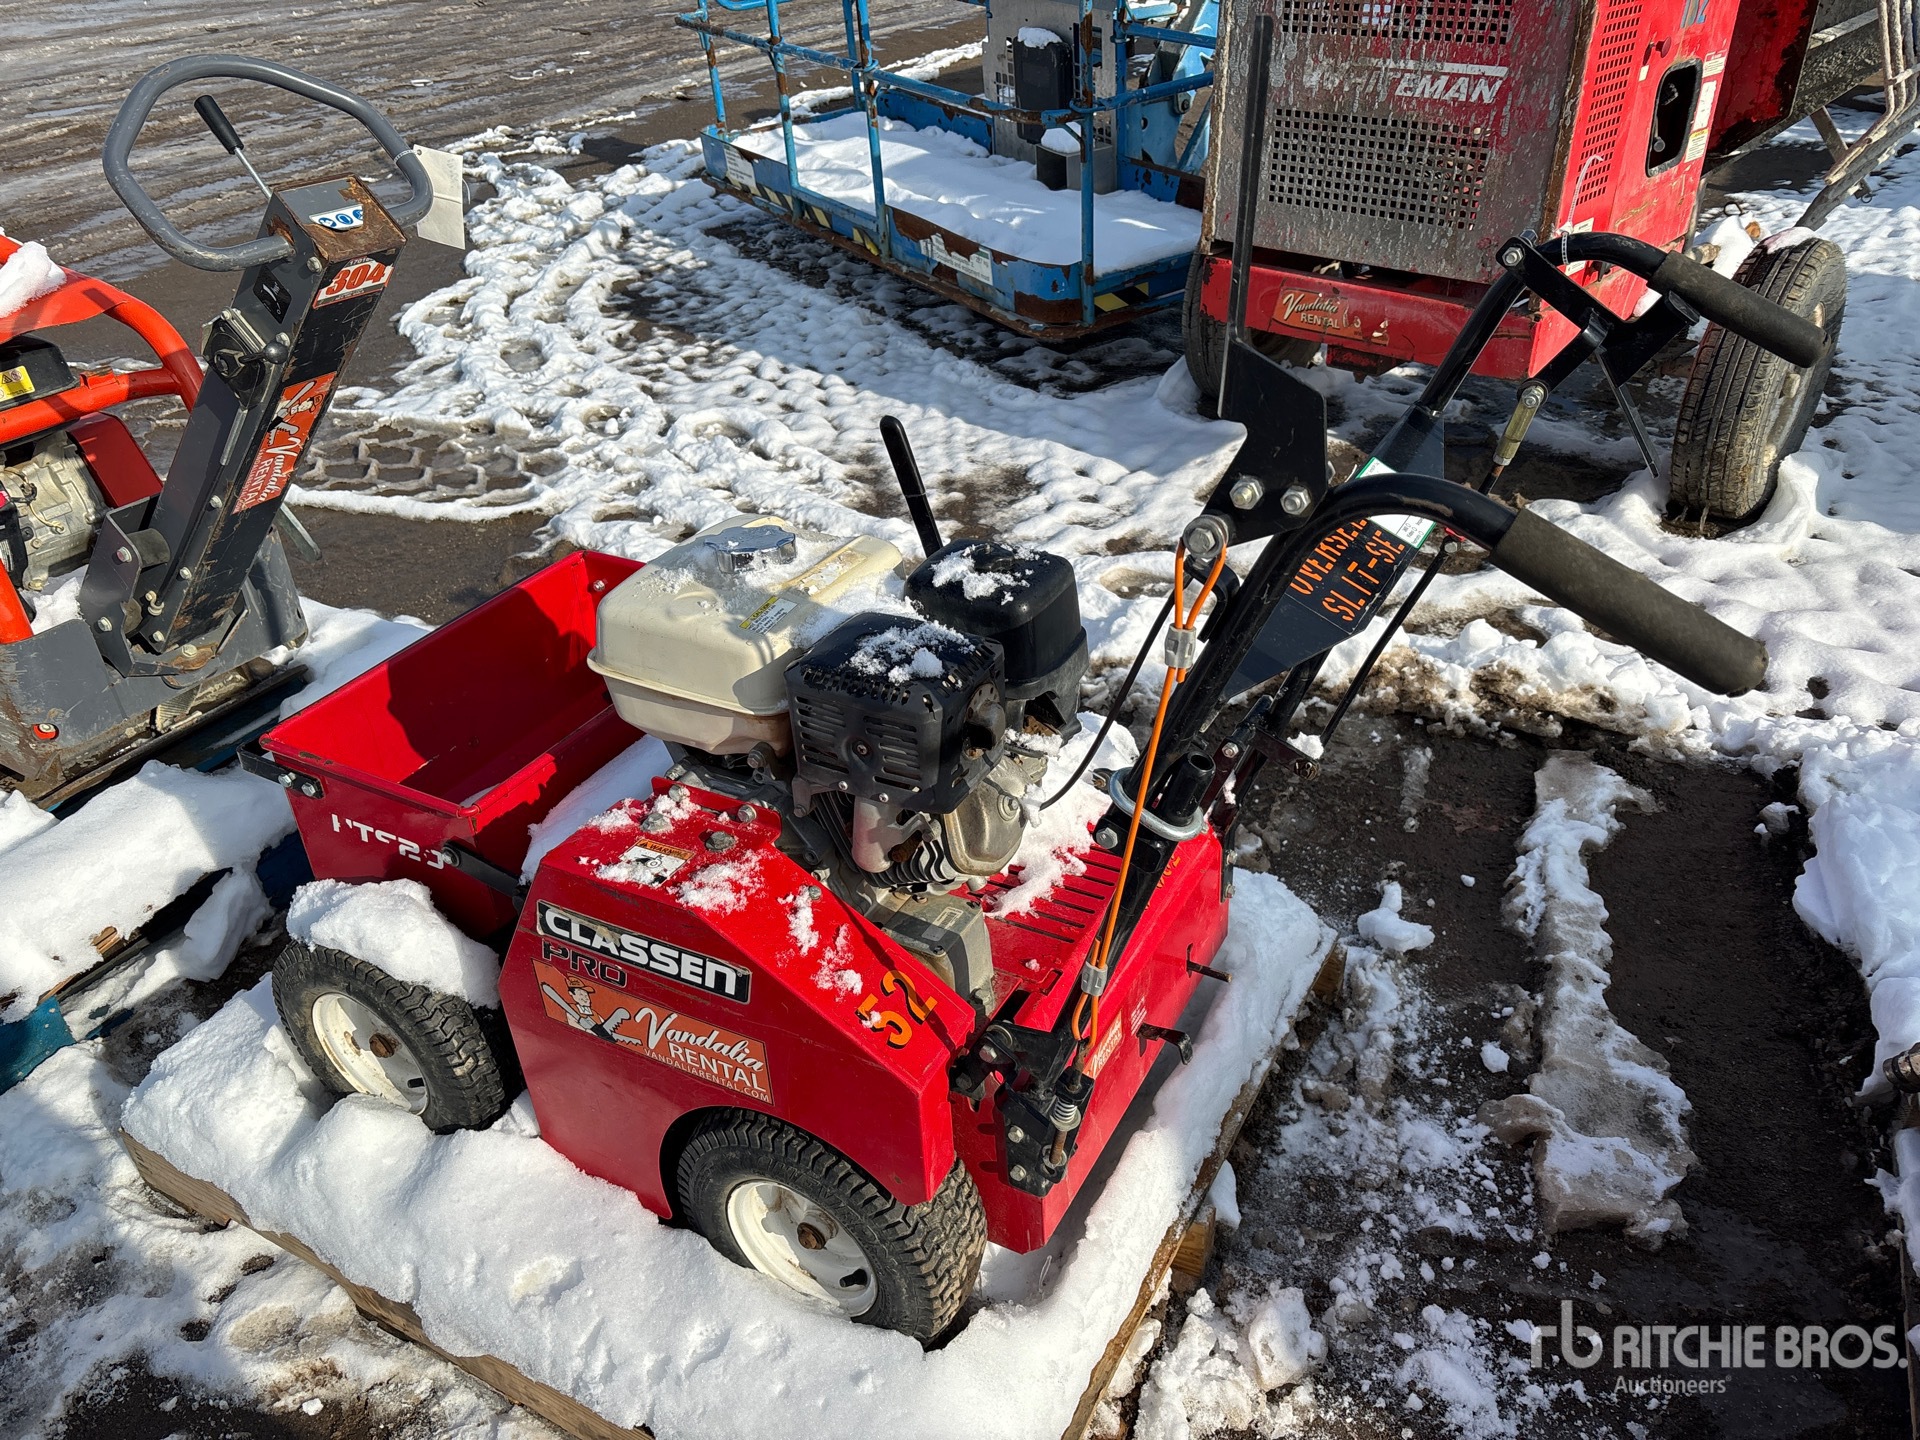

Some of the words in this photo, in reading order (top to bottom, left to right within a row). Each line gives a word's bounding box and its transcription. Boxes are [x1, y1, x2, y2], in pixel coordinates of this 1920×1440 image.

[325, 262, 386, 296] 304
[1283, 293, 1338, 320] Vandalia
[1301, 313, 1340, 328] RENTAL
[244, 458, 273, 505] RENTAL
[258, 436, 301, 502] Vandalia
[542, 938, 627, 988] PRO
[545, 908, 737, 996] CLASSEN
[855, 970, 938, 1049] 52
[634, 1007, 764, 1072] Vandalia
[643, 1048, 770, 1102] VANDALIARENTAL.COM
[668, 1042, 767, 1093] RENTAL
